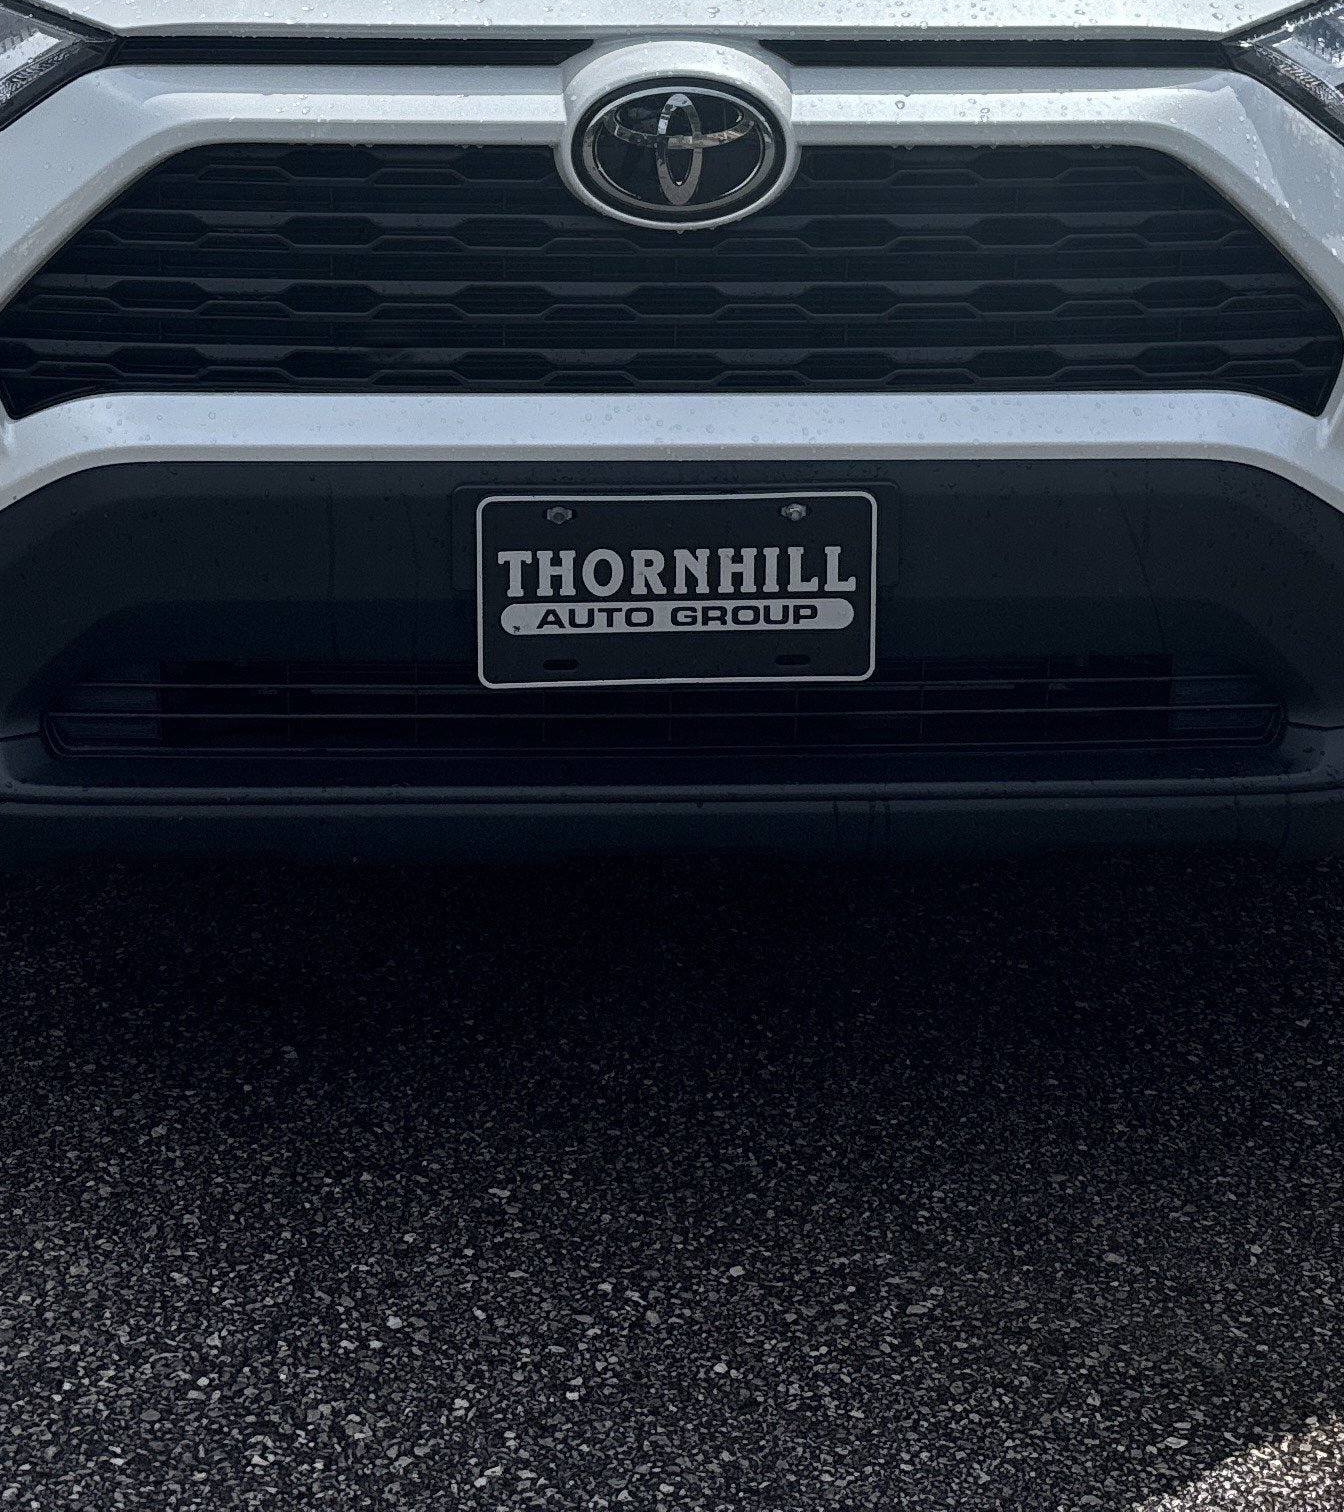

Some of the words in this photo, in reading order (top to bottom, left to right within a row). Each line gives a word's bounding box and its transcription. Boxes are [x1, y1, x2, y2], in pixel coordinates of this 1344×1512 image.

[497, 546, 856, 597] THORNHILL
[536, 607, 650, 630] AUTO
[670, 604, 819, 628] GROUP
